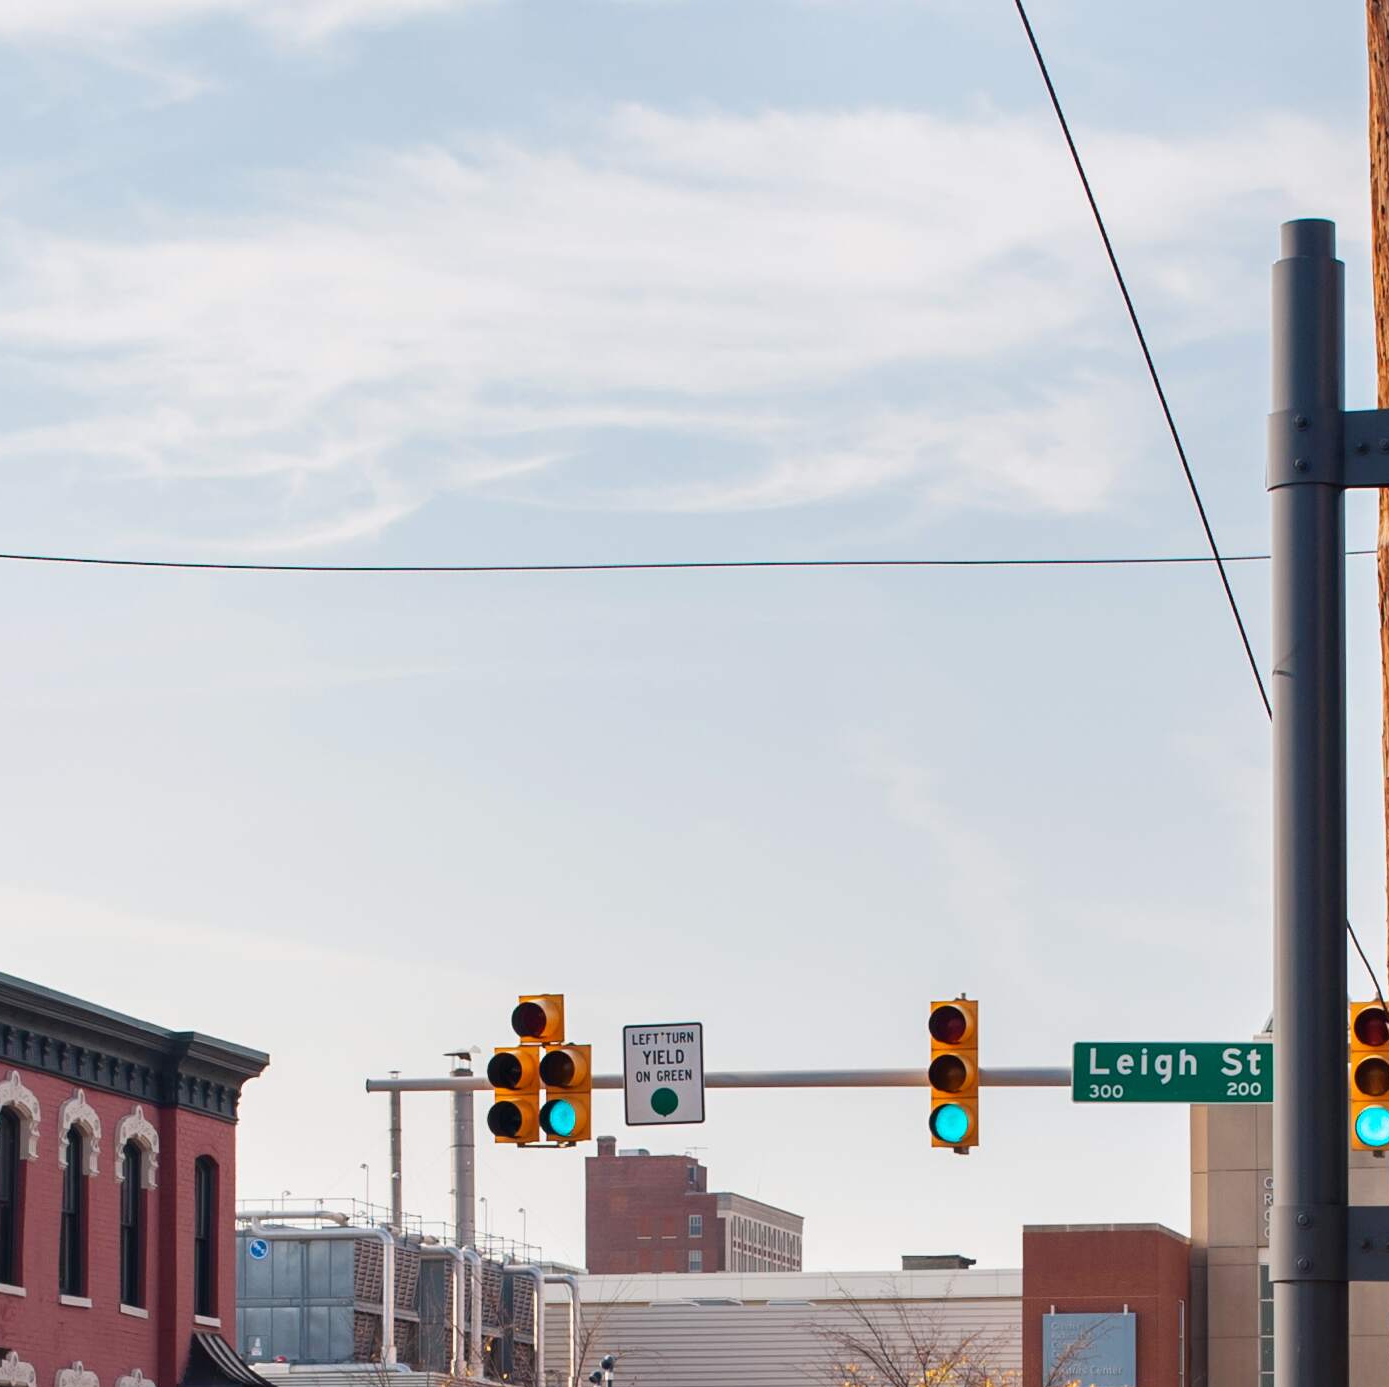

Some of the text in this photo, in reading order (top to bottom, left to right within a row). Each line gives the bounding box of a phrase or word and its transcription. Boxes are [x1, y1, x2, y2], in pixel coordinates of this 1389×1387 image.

[632, 1031, 694, 1046] LEFT TURN
[642, 1049, 685, 1065] YIELD
[1089, 1047, 1262, 1085] Leigh St
[635, 1069, 692, 1083] ON GREEN
[1089, 1081, 1262, 1098] 300 200
